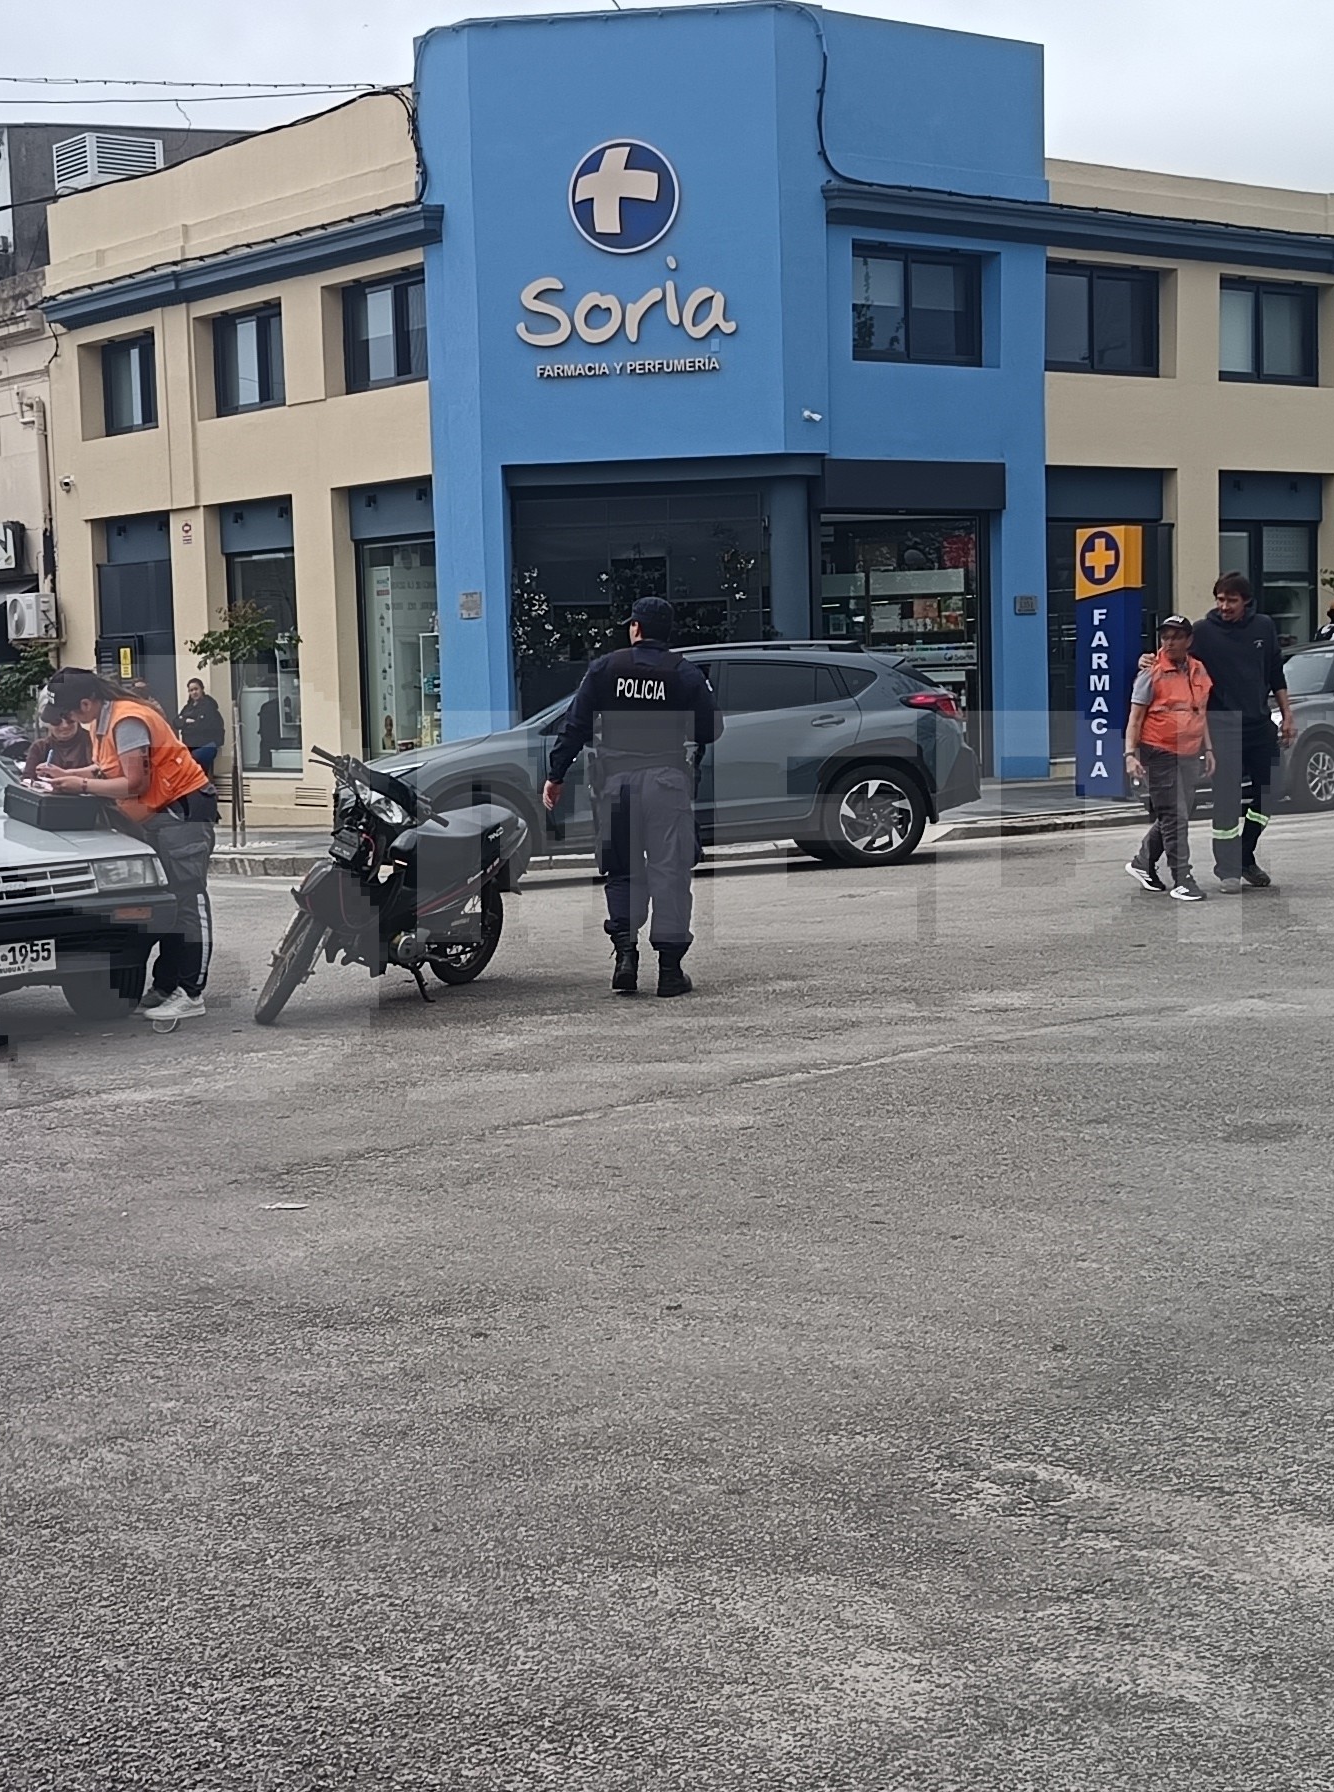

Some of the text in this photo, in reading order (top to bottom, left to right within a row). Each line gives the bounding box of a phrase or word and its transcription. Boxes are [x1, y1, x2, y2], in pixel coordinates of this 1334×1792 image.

[516, 255, 736, 346] Soria
[536, 353, 720, 378] FARMACIA Y PERFUMERÍA
[616, 677, 665, 701] POLICIA
[1089, 609, 1110, 778] FARMACIA
[7, 941, 52, 966] 1955
